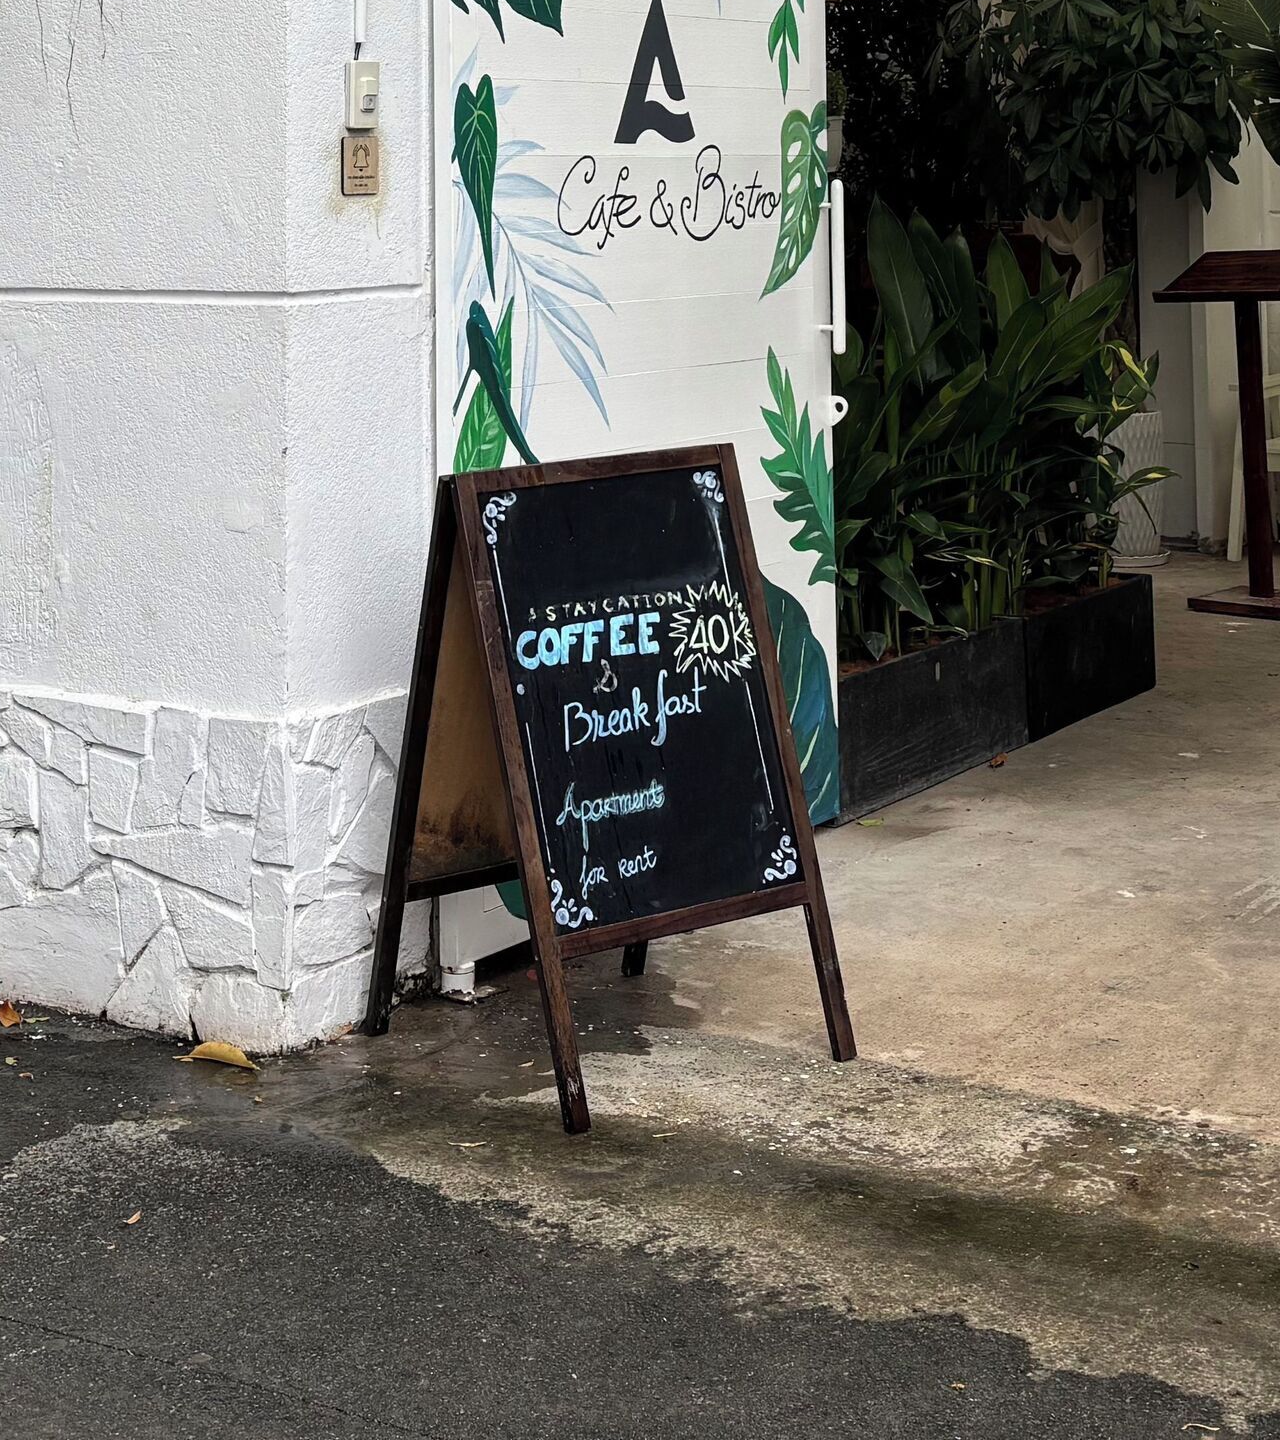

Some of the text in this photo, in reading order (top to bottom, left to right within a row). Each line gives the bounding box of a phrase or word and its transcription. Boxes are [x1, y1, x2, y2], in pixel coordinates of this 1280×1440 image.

[649, 178, 678, 236] &
[680, 144, 781, 242] Bistro
[545, 590, 683, 622] STAYCATION
[688, 610, 749, 660] 40K
[516, 611, 662, 670] COFFEE
[556, 778, 666, 853] Apartment
